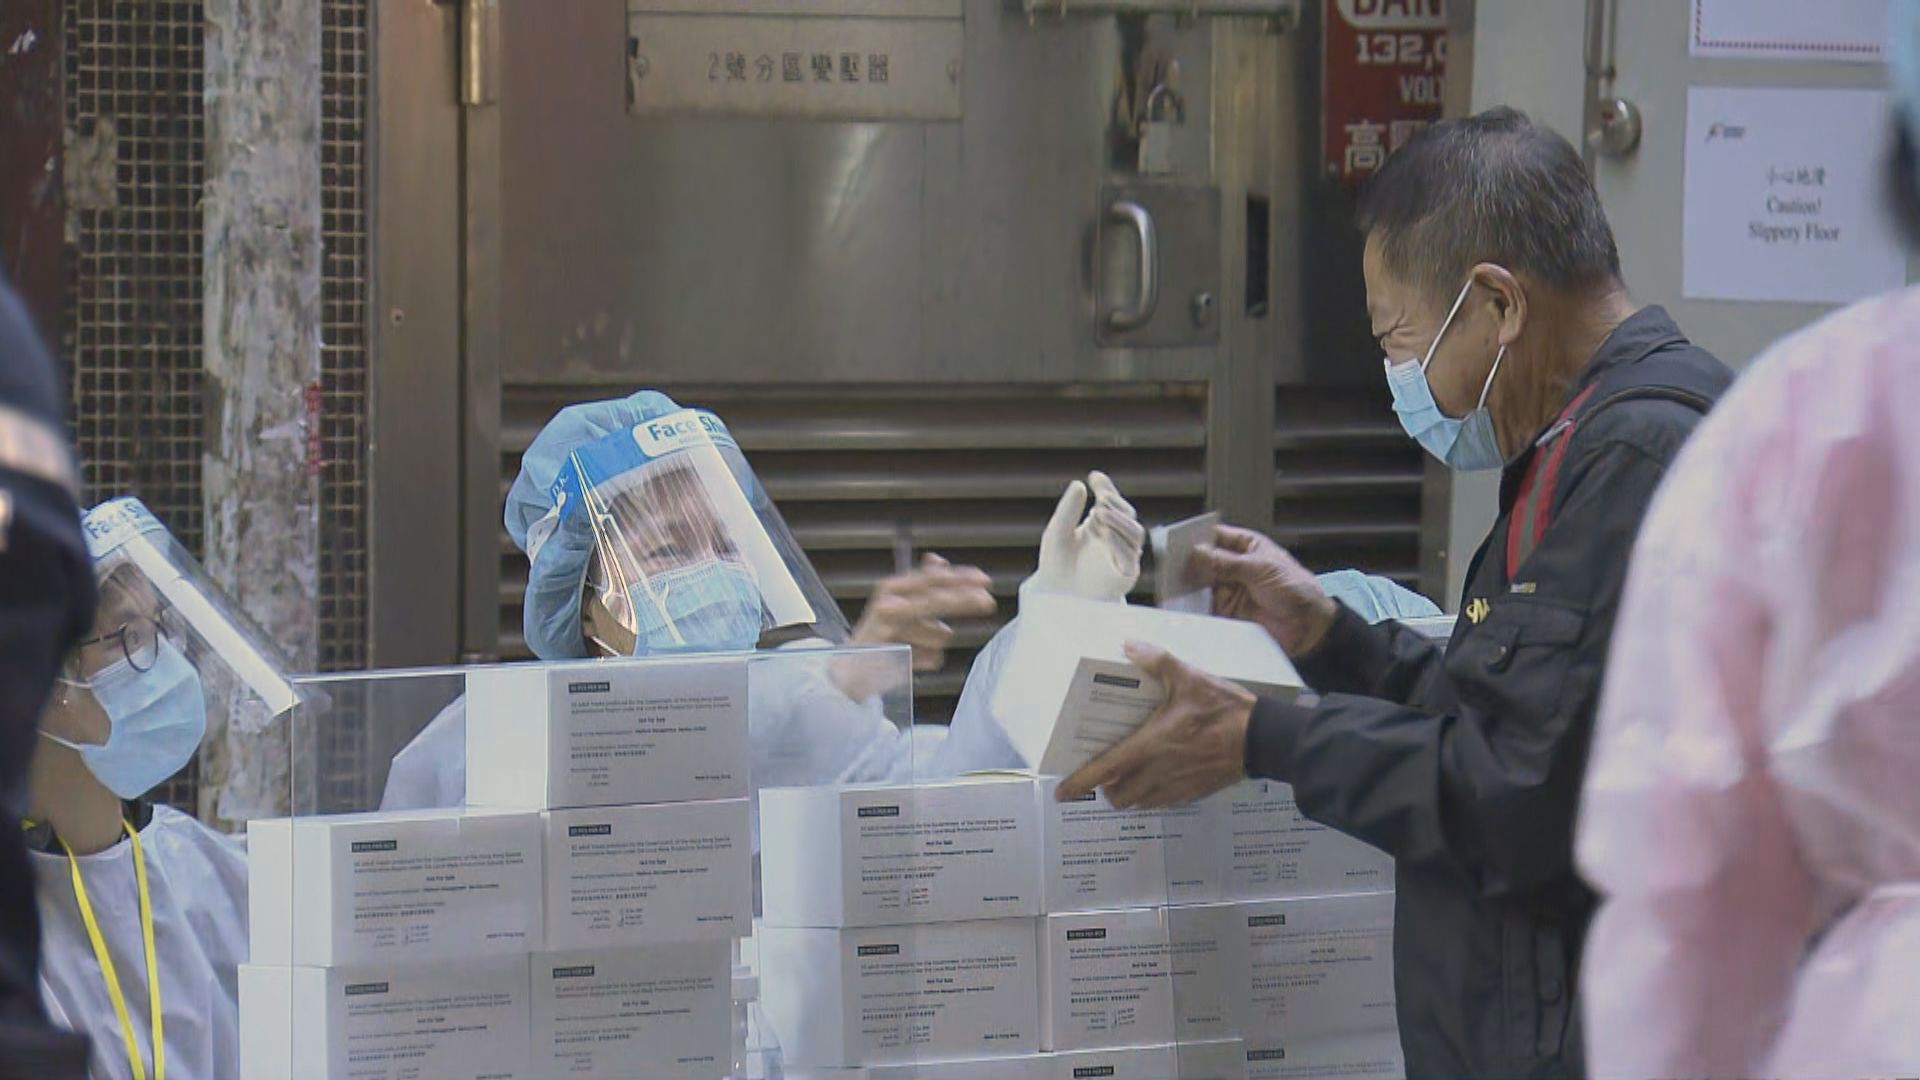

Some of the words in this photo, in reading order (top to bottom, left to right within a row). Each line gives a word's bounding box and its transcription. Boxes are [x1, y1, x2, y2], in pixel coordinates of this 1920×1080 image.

[1766, 196, 1822, 216] Caution!
[1748, 221, 1800, 243] Slippery
[1804, 223, 1841, 242] Floor
[648, 420, 698, 441] Face
